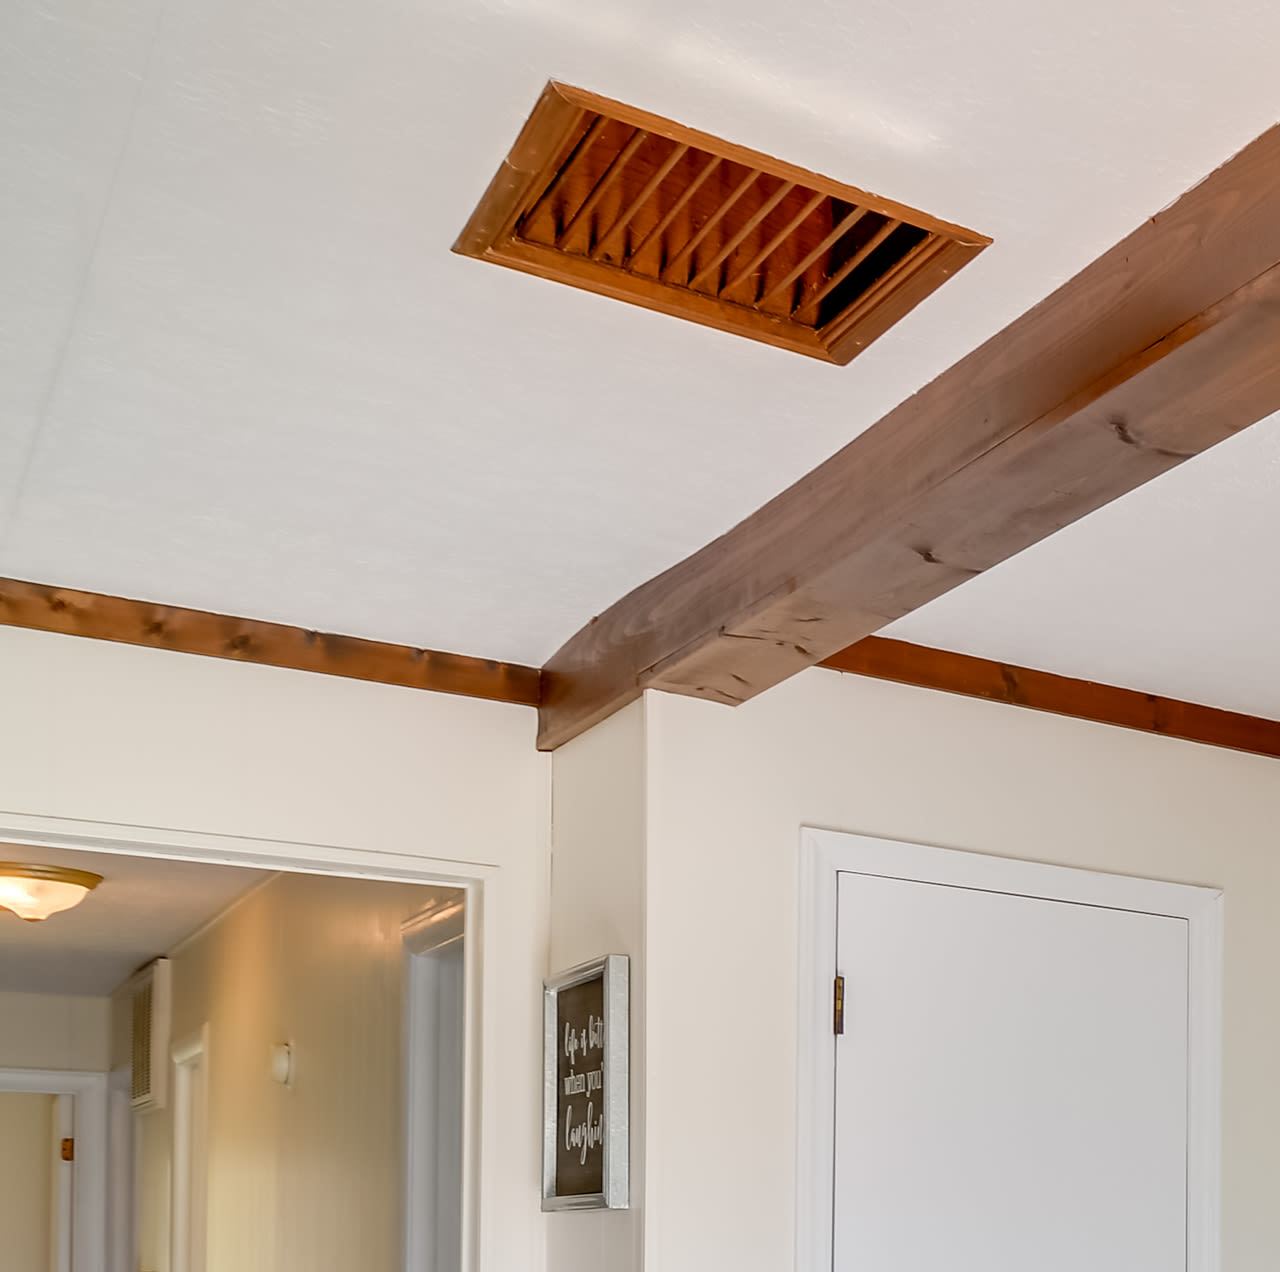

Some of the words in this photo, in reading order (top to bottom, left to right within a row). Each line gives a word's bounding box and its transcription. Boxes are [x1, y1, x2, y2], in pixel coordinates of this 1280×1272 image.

[565, 1022, 579, 1065] life
[589, 1015, 603, 1049] bett
[564, 1069, 585, 1096] when
[566, 1102, 603, 1165] laughin
